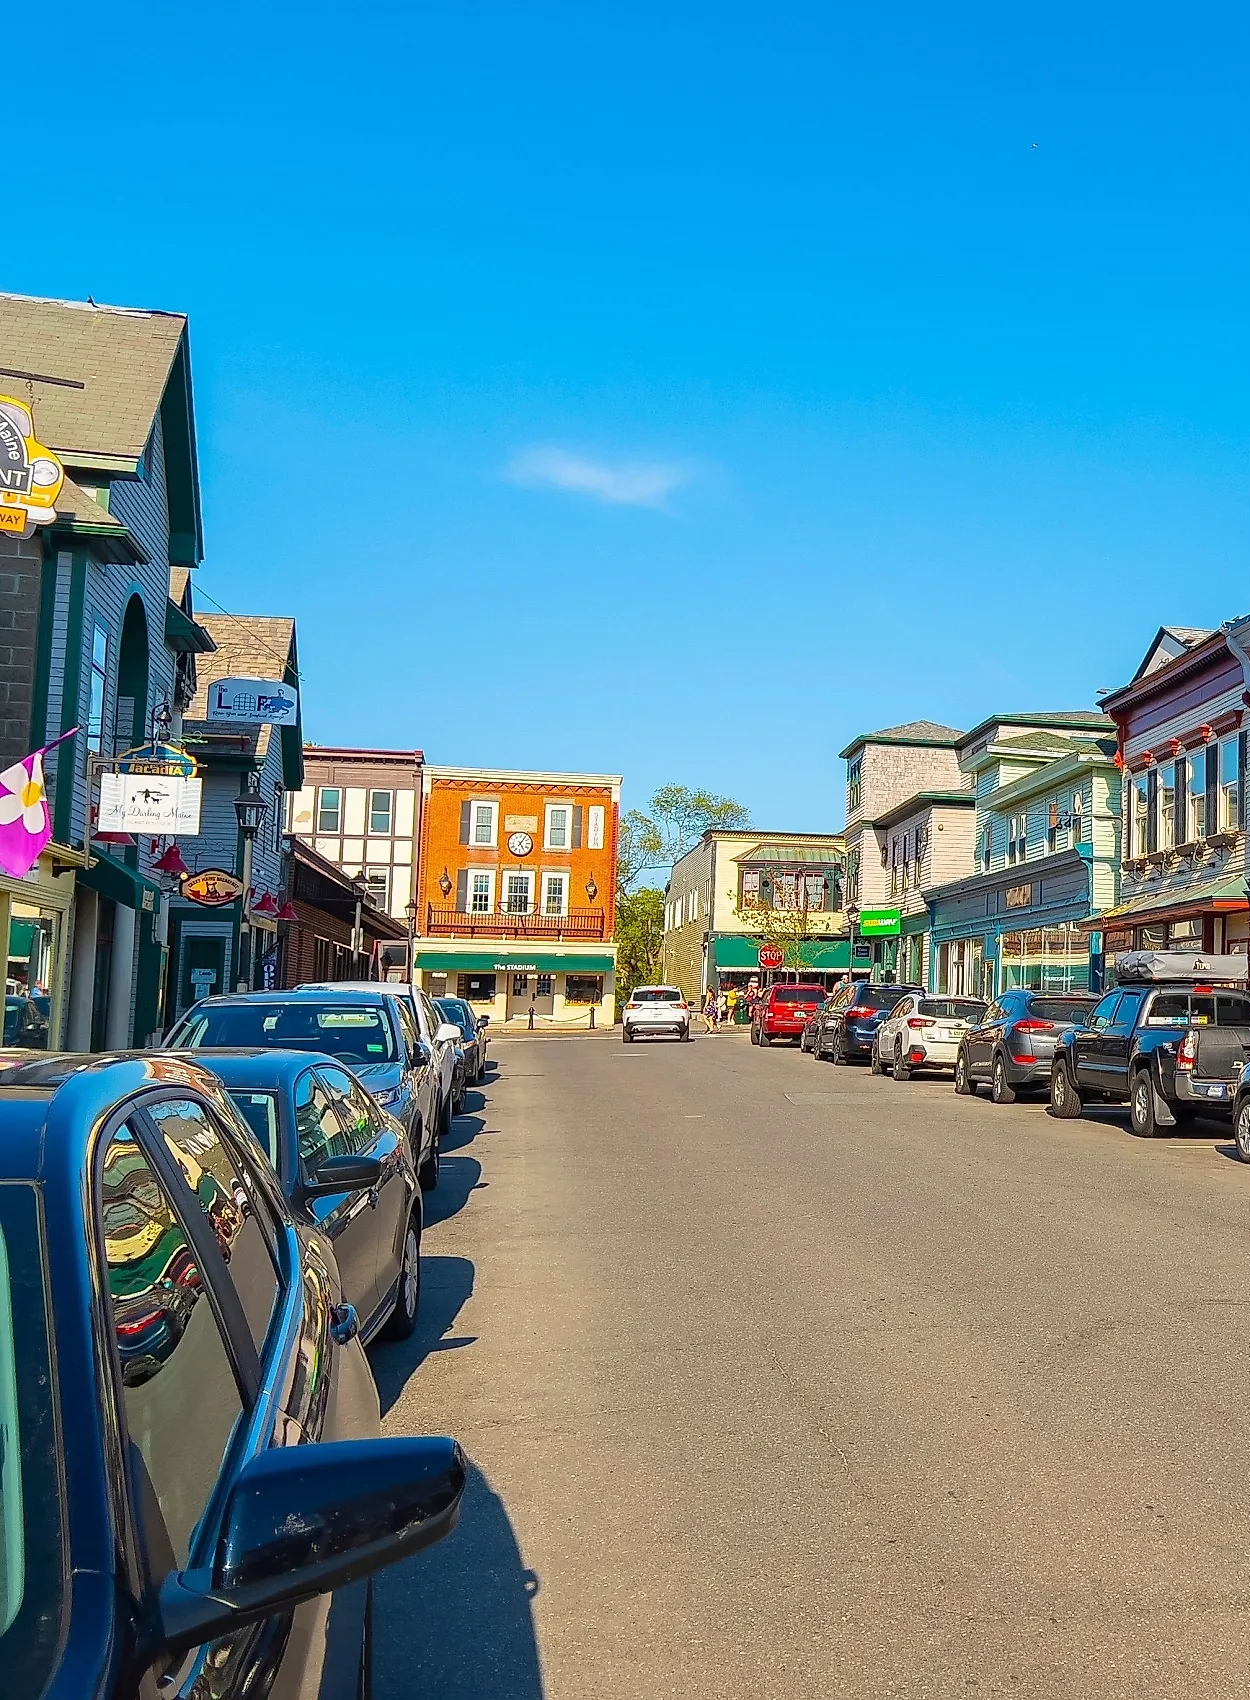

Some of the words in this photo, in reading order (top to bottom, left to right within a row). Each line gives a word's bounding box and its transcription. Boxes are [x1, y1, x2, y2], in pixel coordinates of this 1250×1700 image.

[108, 804, 126, 819] My
[127, 805, 161, 821] Darling
[163, 807, 192, 819] Maine
[862, 918, 898, 927] SUBWAY
[760, 950, 783, 961] STOP
